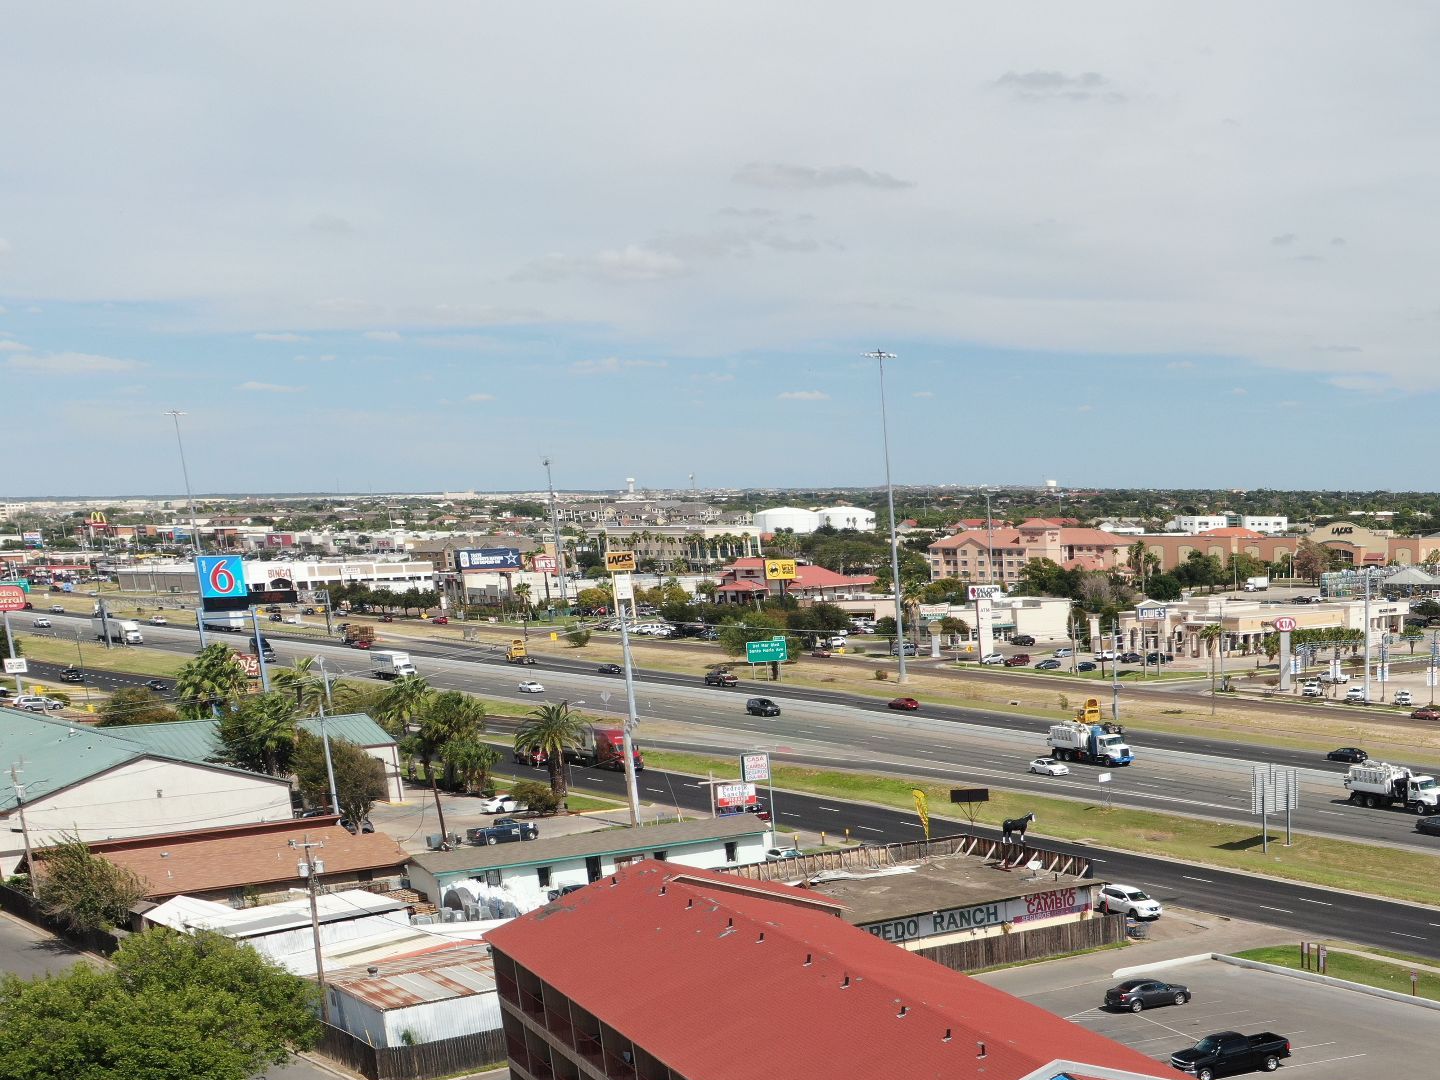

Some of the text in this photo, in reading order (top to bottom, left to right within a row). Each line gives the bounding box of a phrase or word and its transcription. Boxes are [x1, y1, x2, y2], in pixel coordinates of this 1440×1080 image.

[608, 553, 633, 564] LACKS
[210, 560, 236, 593] 6
[268, 569, 291, 578] BINGO
[1139, 608, 1165, 618] LOWE'S
[1279, 620, 1294, 629] KIA
[1027, 895, 1075, 914] CAMBIO
[866, 905, 999, 941] REDO RANCH
